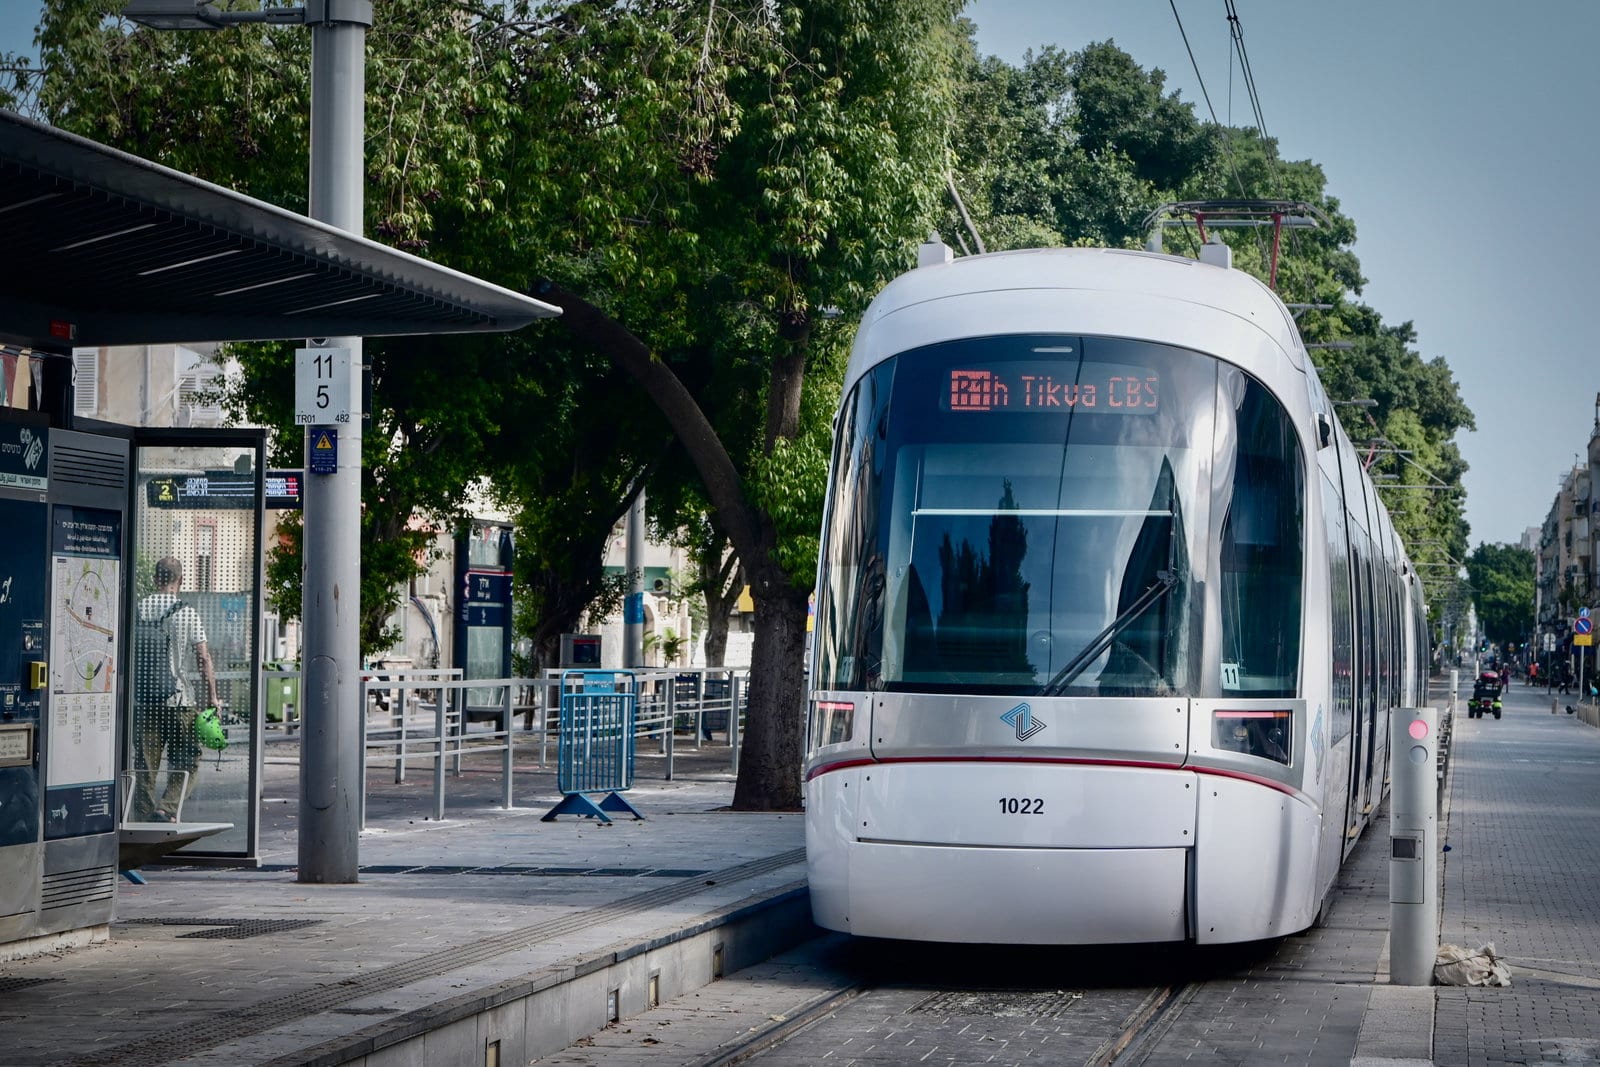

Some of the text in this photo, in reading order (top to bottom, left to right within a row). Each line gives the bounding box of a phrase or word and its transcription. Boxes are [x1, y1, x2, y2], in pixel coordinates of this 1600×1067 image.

[313, 354, 333, 379] 11
[316, 384, 330, 409] 5
[1022, 375, 1097, 408] Tikva
[1108, 376, 1158, 408] CBS
[296, 414, 317, 424] TR01
[335, 413, 350, 423] 482
[161, 485, 170, 495] 2
[1224, 667, 1237, 684] 11
[999, 797, 1044, 815] 1022
